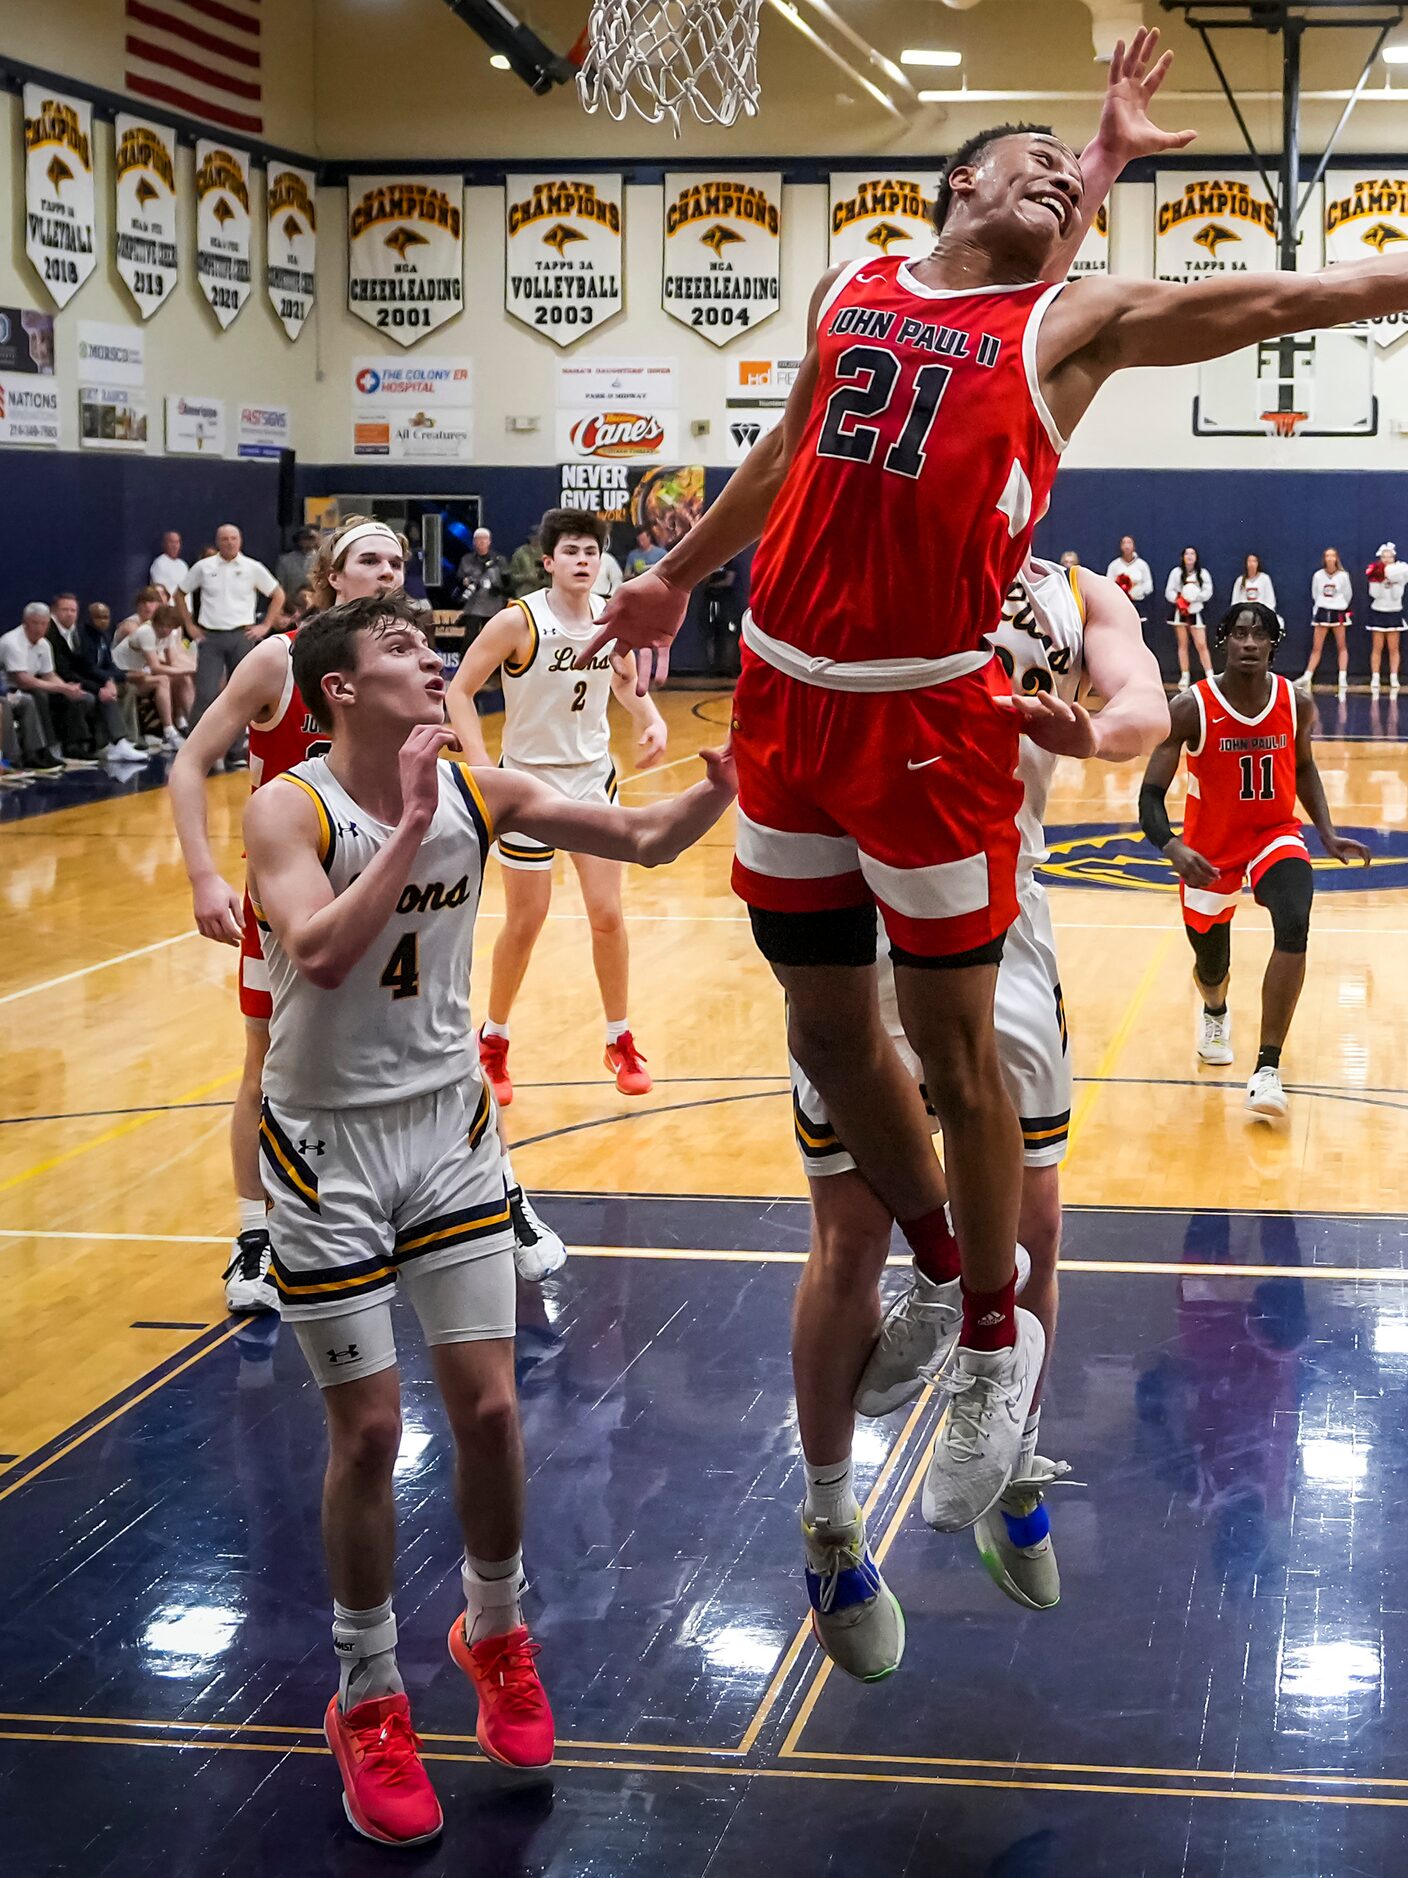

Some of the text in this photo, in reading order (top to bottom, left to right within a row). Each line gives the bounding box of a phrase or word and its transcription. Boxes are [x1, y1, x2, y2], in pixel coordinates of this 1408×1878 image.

[533, 180, 596, 198] STATE
[679, 181, 766, 203] NATIONAL
[858, 179, 921, 194] STATE
[1185, 180, 1249, 195] STATE
[351, 196, 461, 240] CHAMPIONS
[508, 192, 621, 237] CHAMPIONS
[666, 192, 779, 238] CHAMPIONS
[832, 190, 930, 236] CHAMPIO
[1158, 192, 1276, 237] CHAMPIONS
[29, 212, 93, 253] VOLLEYBALL
[44, 256, 78, 284] 2018
[394, 263, 418, 273] NCA
[535, 261, 594, 271] TAPPS 3A
[709, 262, 733, 272] NCA
[1073, 260, 1106, 270] GIRLS
[1185, 261, 1225, 271] TAPPS
[134, 271, 163, 296] 2019
[350, 278, 460, 301] CHEERLEADING
[511, 275, 618, 300] VOLLEYBALL
[665, 276, 778, 300] CHEERLEADING
[211, 285, 239, 310] 2020
[280, 298, 305, 320] 2021
[376, 308, 431, 327] 2001
[534, 306, 594, 325] 2003
[691, 307, 750, 326] 2004
[827, 308, 897, 340] JOHN
[896, 317, 971, 358] PAUL
[382, 369, 469, 381] THE COLONY ER
[381, 382, 435, 393] HOSPITAL
[816, 344, 953, 479] 21
[413, 429, 468, 440] Creatures
[562, 465, 628, 489] NEVER
[561, 490, 630, 511] GIVE UP
[571, 680, 588, 711] 2
[1219, 737, 1248, 752] JOHN
[1250, 735, 1279, 751] PAUL
[1239, 754, 1275, 801] 11
[379, 931, 420, 1001] 4
